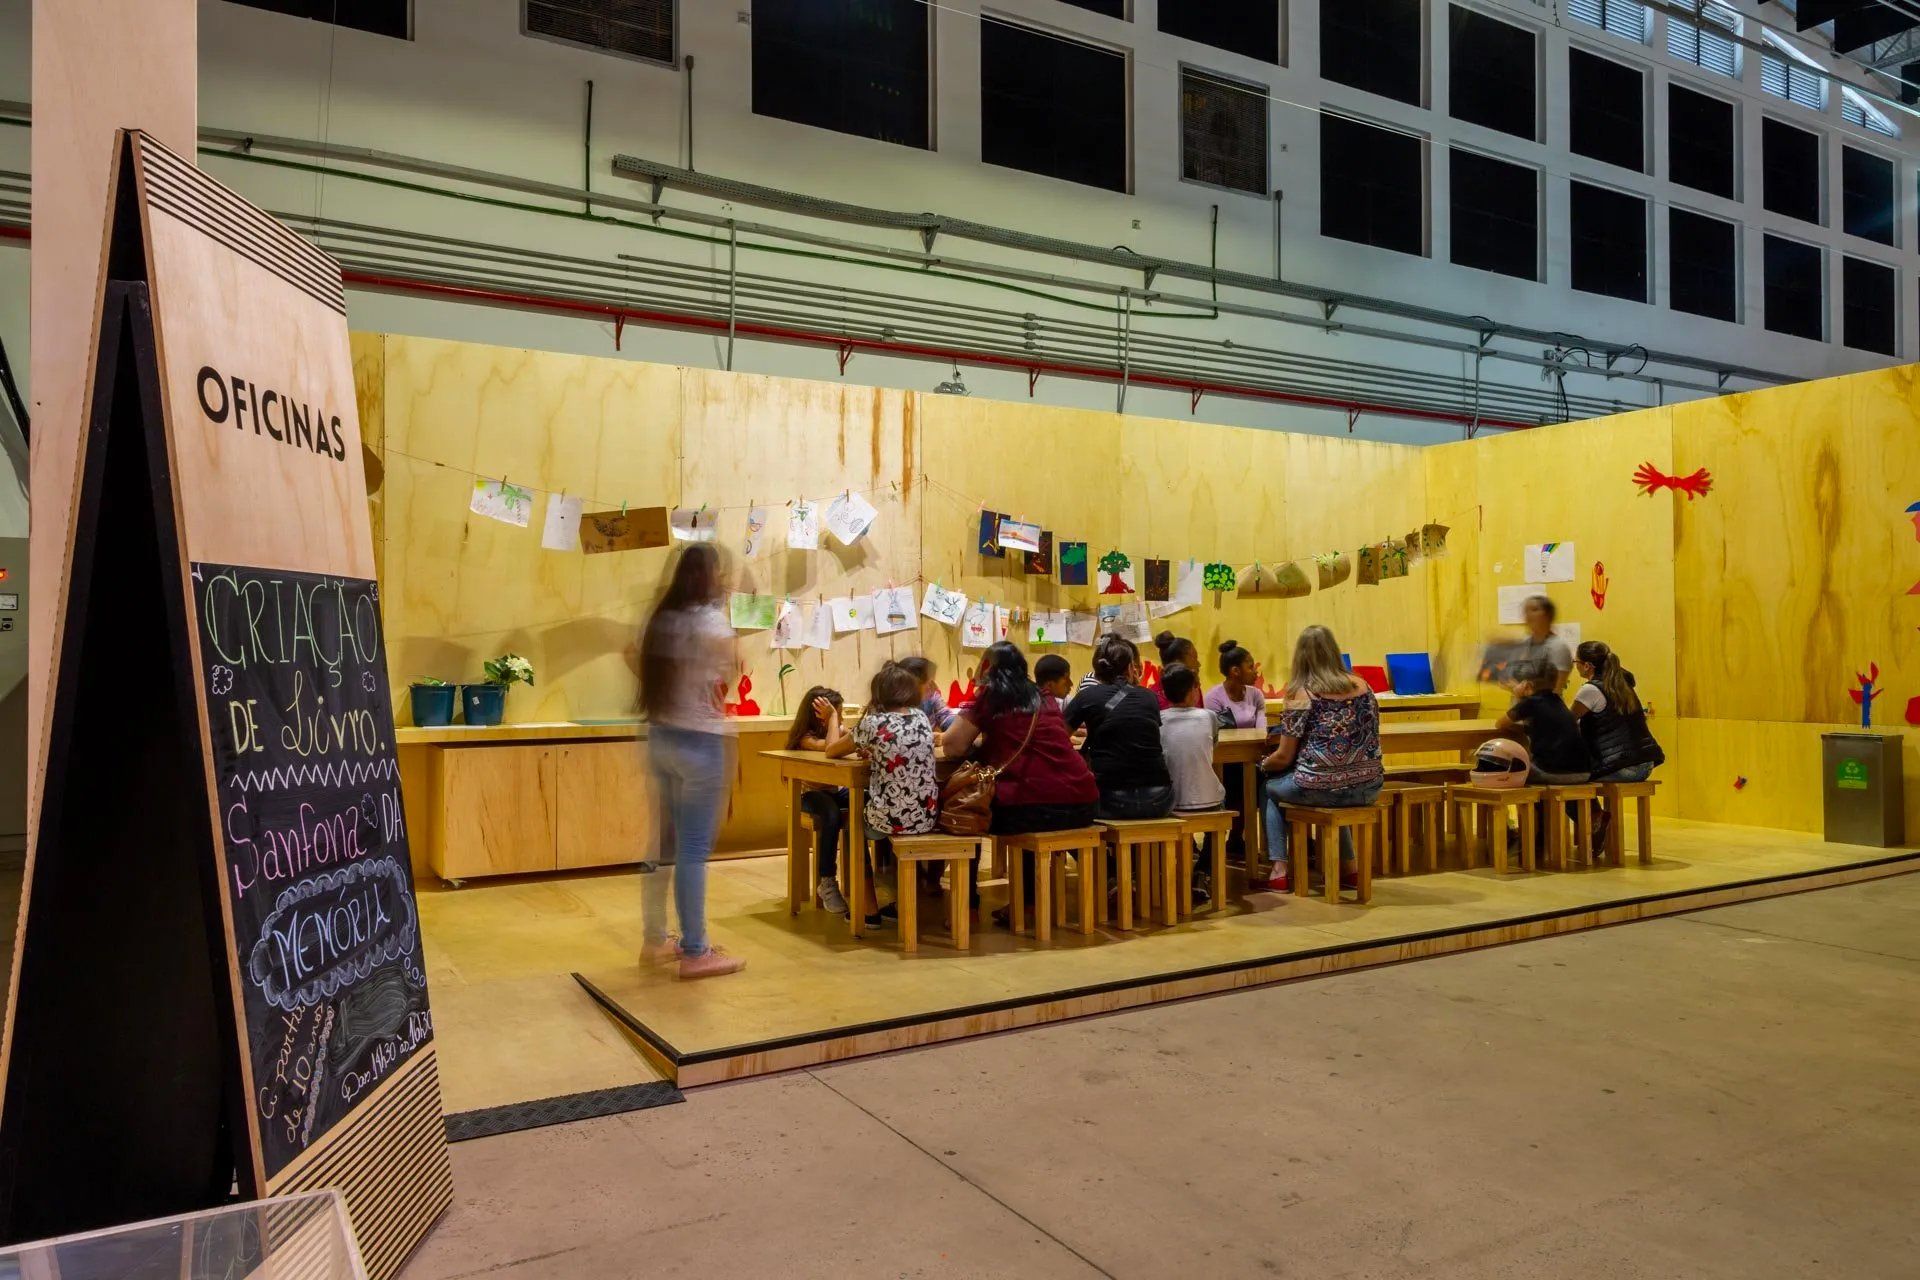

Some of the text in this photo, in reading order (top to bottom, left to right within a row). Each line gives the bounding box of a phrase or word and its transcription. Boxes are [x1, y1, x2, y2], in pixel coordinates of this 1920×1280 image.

[197, 366, 345, 462] OFICINAS
[205, 571, 378, 687] CRIAÇÃO
[230, 700, 264, 754] DE
[228, 787, 404, 898] Sanfona DA
[293, 1056, 311, 1096] 10
[284, 1102, 304, 1143] de
